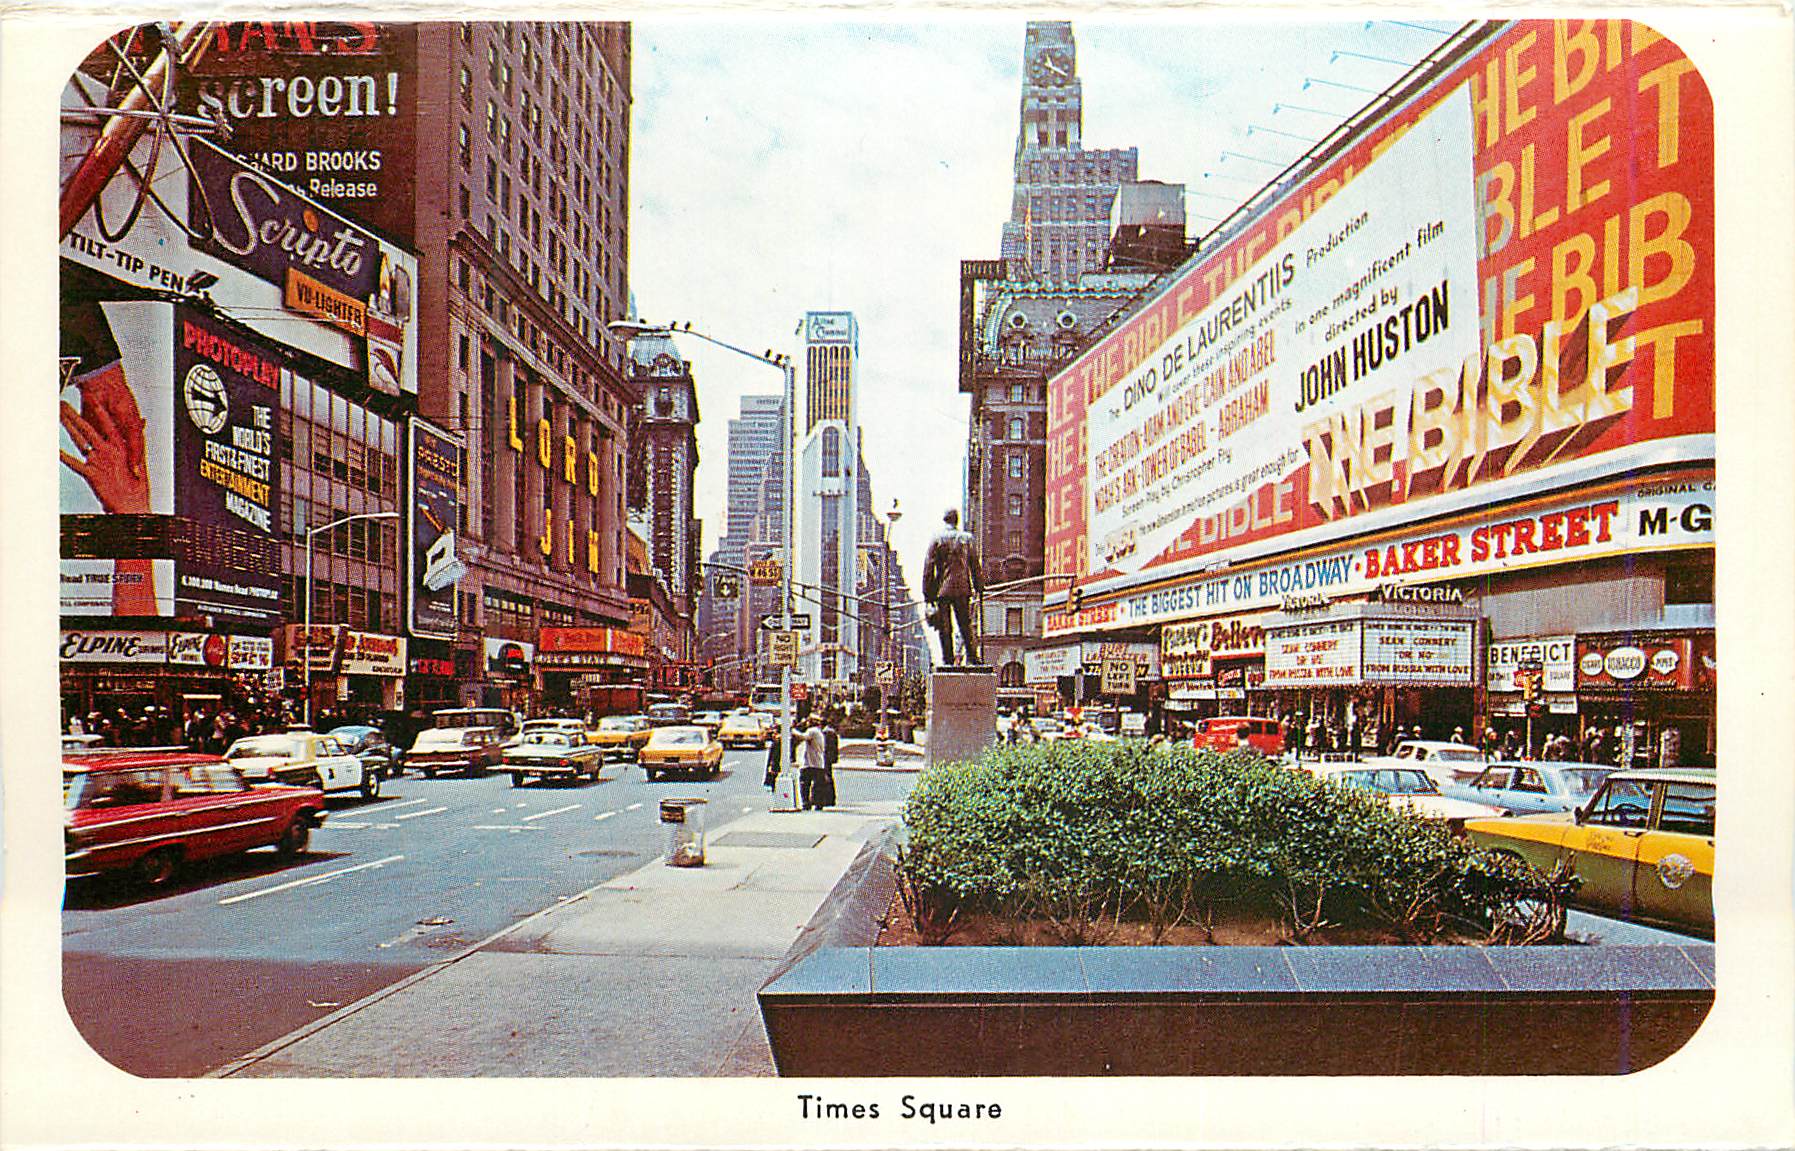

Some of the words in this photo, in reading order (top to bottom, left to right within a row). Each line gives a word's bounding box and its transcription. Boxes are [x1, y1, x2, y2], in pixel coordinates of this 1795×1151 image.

[197, 73, 398, 118] screen!
[306, 151, 381, 171] BROOKS
[309, 178, 377, 198] Release
[213, 171, 363, 277] Scripto
[68, 231, 144, 273] TILT-TIP
[149, 264, 184, 292] PEN
[1295, 320, 1306, 335] in
[1309, 305, 1329, 325] one
[1332, 243, 1411, 310] magnificent
[1417, 220, 1444, 248] film
[1124, 368, 1156, 410] DINO
[1163, 344, 1184, 382] DE
[1188, 253, 1295, 361] LAURENTIIS
[1306, 211, 1368, 268] Production
[1325, 296, 1377, 342] directed
[1381, 286, 1398, 307] by
[183, 320, 279, 391] PHOTOPLAY
[1250, 328, 1276, 373] ABEL
[1295, 346, 1347, 412] JOHN
[1353, 280, 1449, 381] HUSTON
[1408, 285, 1638, 473] BIBLE
[252, 405, 271, 430] THE
[1218, 377, 1269, 442] ABRAHAM
[232, 425, 271, 456] WORLD'S
[200, 458, 271, 508] ENTERTAINMENT
[1637, 483, 1696, 497] ORIGINAL
[225, 491, 271, 533] MAGAZINE
[1364, 532, 1462, 579] BAKER
[1471, 501, 1620, 563] STREET
[1128, 598, 1147, 617] THE
[1151, 583, 1202, 615] BIGGEST
[1207, 579, 1226, 604] HIT
[1233, 575, 1251, 600] ON
[1259, 554, 1352, 597] BROADWAY
[1379, 582, 1463, 602] VICTORIA
[1078, 601, 1118, 627] STREET
[60, 632, 142, 659] ELPINE
[1110, 662, 1129, 672] NO
[1424, 664, 1446, 673] WITH
[1447, 665, 1470, 674] LOVE
